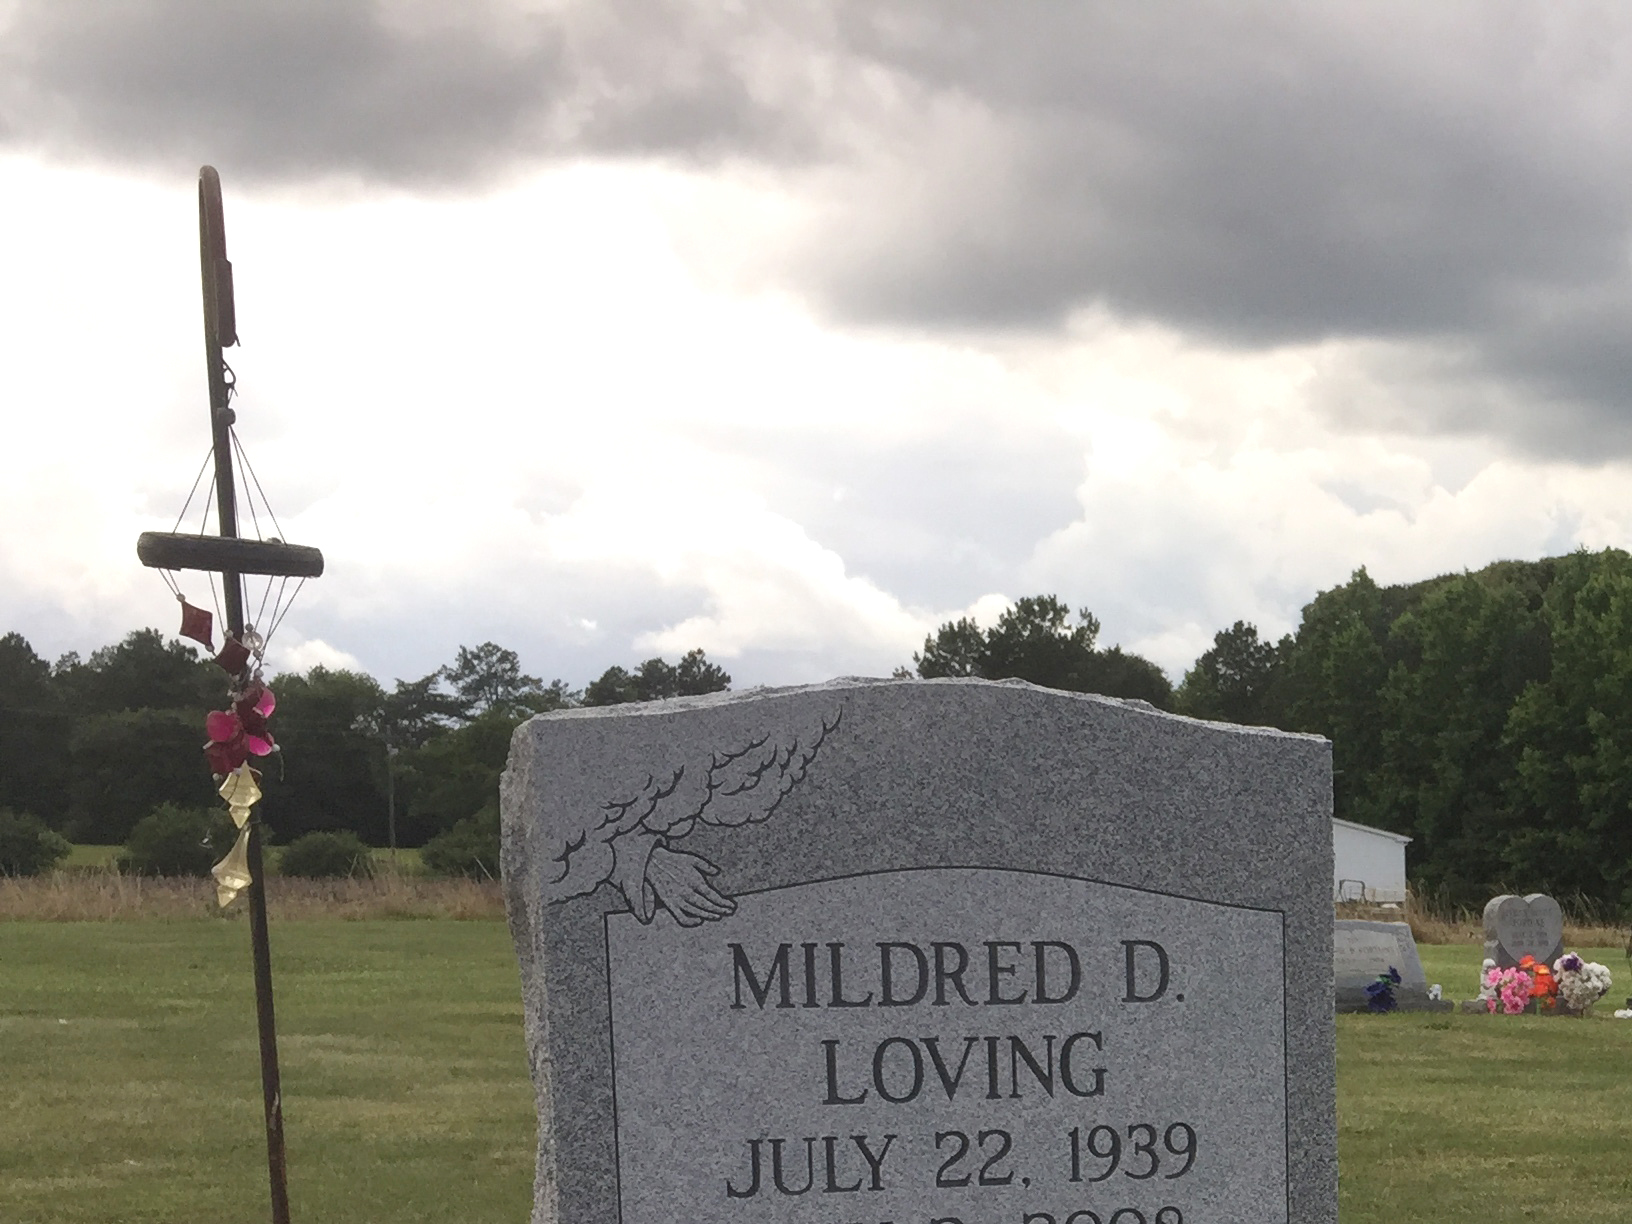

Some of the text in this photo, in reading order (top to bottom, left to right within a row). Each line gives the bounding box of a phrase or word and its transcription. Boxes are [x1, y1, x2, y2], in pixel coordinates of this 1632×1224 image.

[727, 939, 1186, 1010] MILDRED D.
[821, 1030, 1109, 1106] LOVING
[726, 1121, 1198, 1200] JULY 22, 1939
